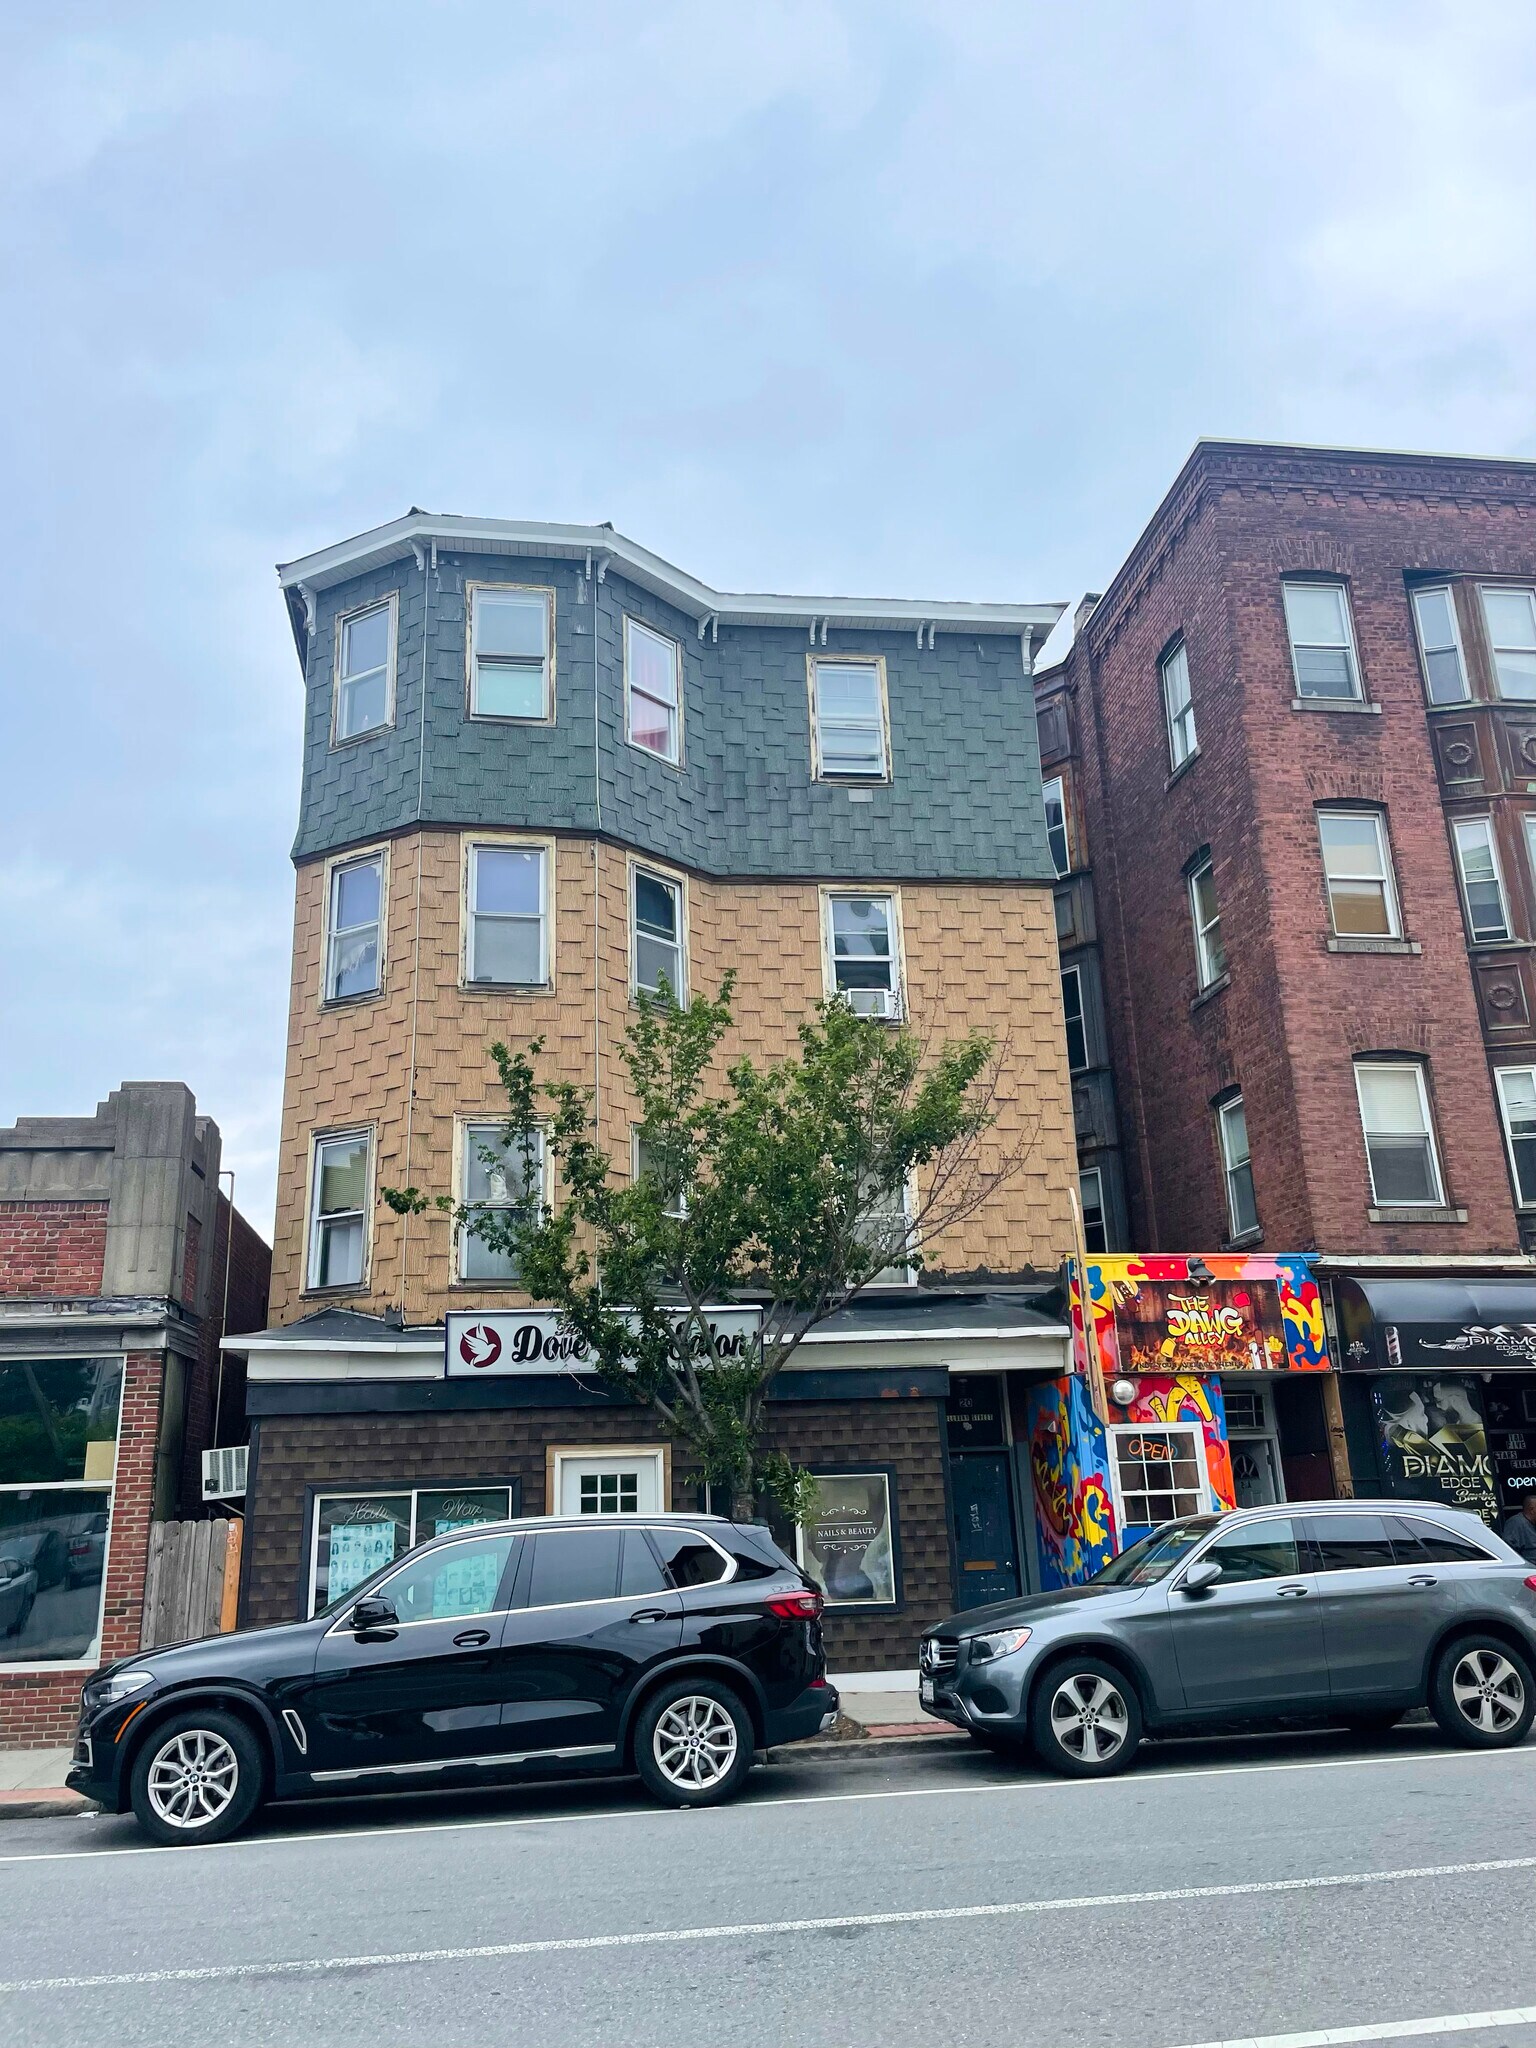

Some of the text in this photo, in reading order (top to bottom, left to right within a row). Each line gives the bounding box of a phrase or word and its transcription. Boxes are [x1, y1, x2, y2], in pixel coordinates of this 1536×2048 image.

[1167, 1293, 1210, 1312] THE
[1166, 1306, 1243, 1336] DAWG
[511, 1325, 589, 1363] Dove
[1184, 1331, 1226, 1345] ALLEY
[1128, 1439, 1174, 1461] OPEN
[1441, 1477, 1481, 1489] EDGE
[817, 1529, 840, 1538] NAILS
[848, 1527, 878, 1535] BEAUTY
